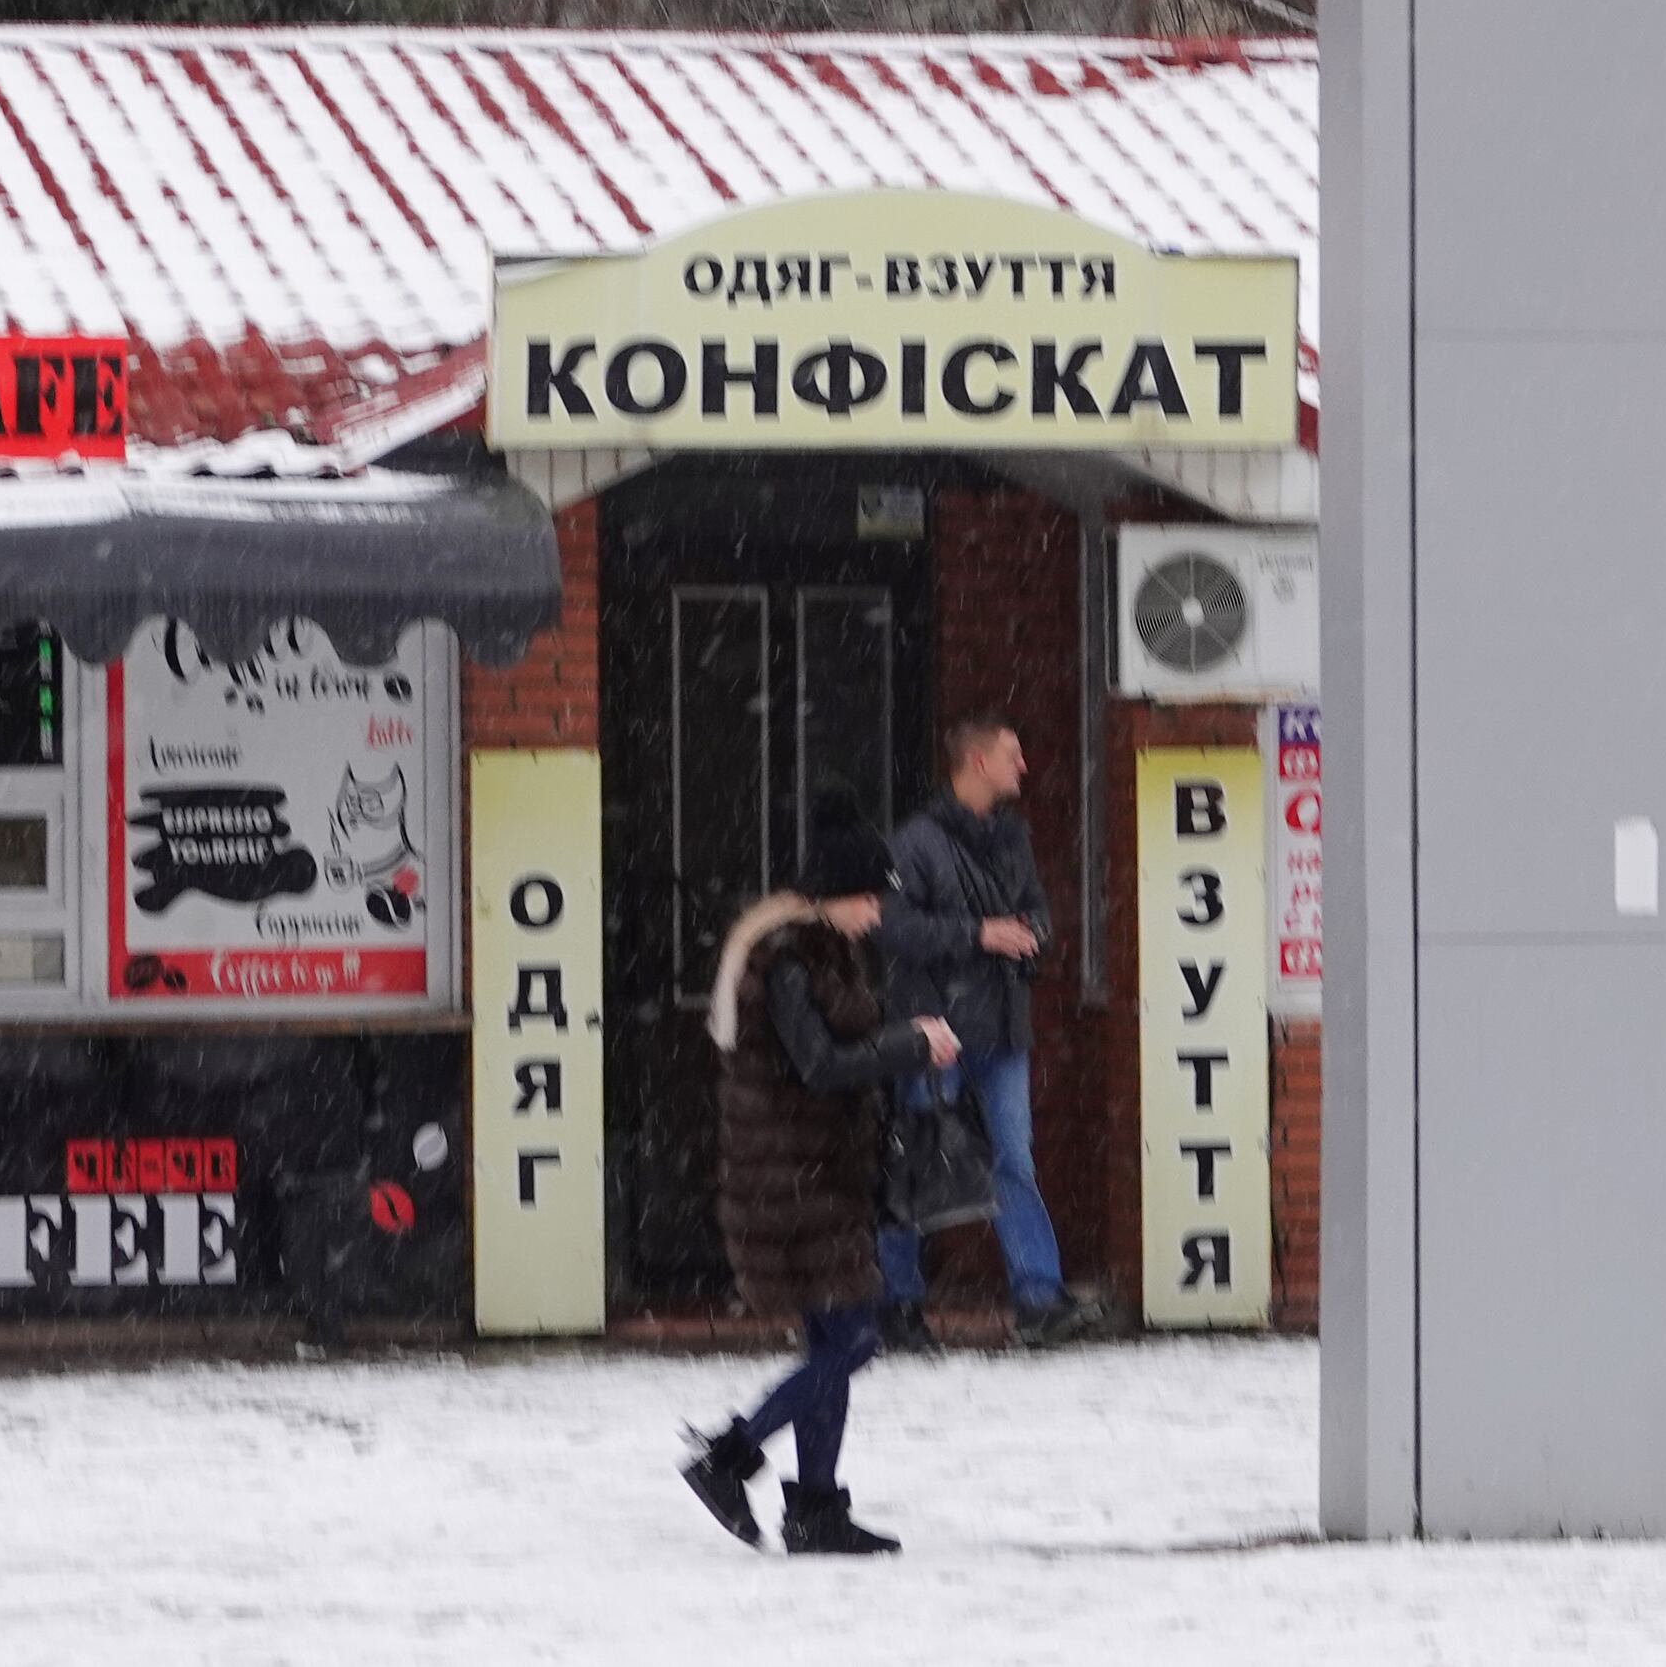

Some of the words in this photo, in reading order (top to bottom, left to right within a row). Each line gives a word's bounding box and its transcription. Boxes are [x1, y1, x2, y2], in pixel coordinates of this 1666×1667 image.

[523, 337, 1266, 423] КОНФІСКАТ
[506, 873, 569, 1206] ОДЯГ
[1173, 778, 1235, 1291] ВЗУТТЯ
